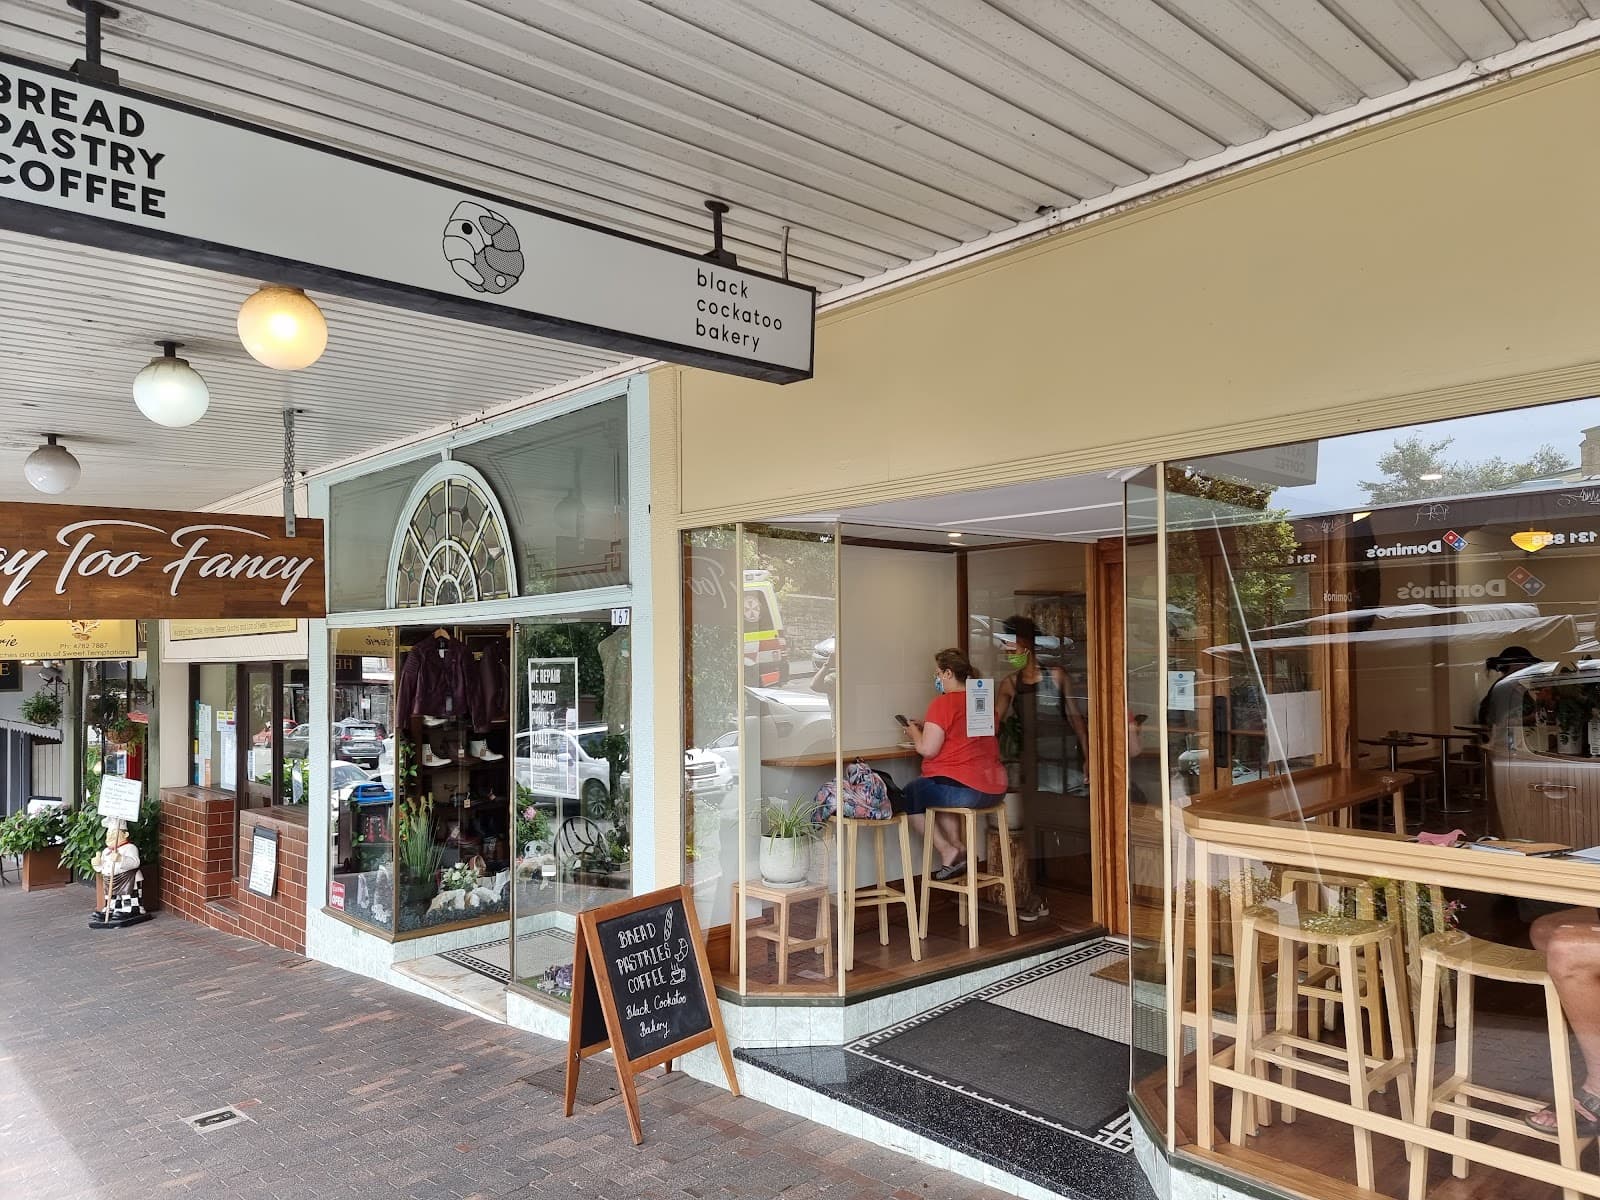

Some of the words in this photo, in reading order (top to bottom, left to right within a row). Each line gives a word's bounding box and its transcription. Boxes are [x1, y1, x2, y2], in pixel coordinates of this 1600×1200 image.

[0, 73, 145, 137] BREAD
[697, 267, 748, 298] black
[696, 299, 782, 330] cockatoo
[696, 318, 760, 352] bakery
[55, 520, 167, 595] Too
[163, 524, 314, 606] Fancy
[613, 610, 629, 624] 167
[62, 649, 86, 657] Sweet
[617, 922, 656, 949] BREAD
[615, 942, 672, 976] PASTRIES
[627, 966, 667, 994] COFFEE
[625, 999, 651, 1020] Black
[639, 1018, 670, 1039] Bakery
